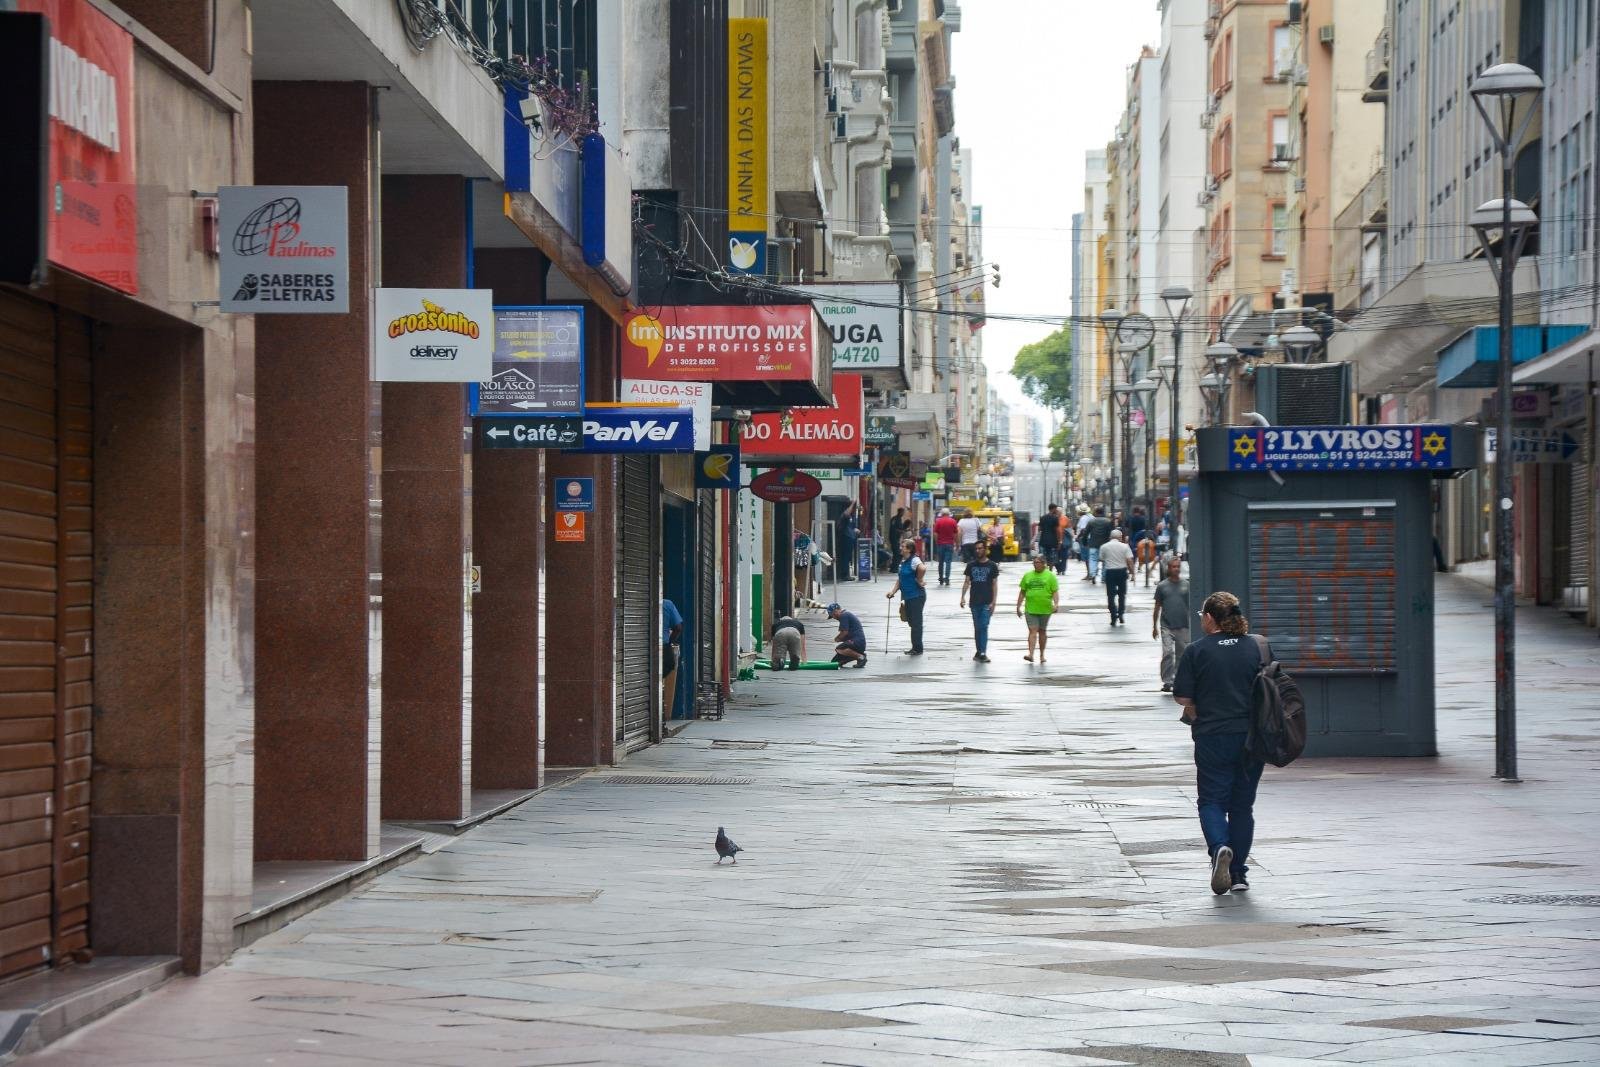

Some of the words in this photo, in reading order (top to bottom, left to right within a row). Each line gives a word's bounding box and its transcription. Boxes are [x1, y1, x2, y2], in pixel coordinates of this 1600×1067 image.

[738, 33, 753, 99] NOIVAS
[738, 107, 753, 144] DAS
[738, 151, 753, 217] RAINHA
[261, 221, 337, 257] Paulinas
[260, 274, 334, 287] SABERES
[388, 311, 480, 340] croasonho
[665, 325, 761, 340] INSTITUTO
[767, 325, 804, 340] MIX
[410, 346, 458, 360] delivery
[665, 343, 686, 352] DE
[697, 341, 807, 352] PROFISSÕES
[480, 381, 535, 390] NOLASCO
[630, 384, 703, 397] ALUGA-SE
[513, 424, 557, 441] Café
[582, 420, 680, 443] PanVel
[743, 423, 771, 439] DO
[779, 420, 854, 440] ALEMÃO
[1330, 452, 1343, 460] 51
[1346, 452, 1353, 460] 9
[1356, 451, 1413, 460] 9242.3387
